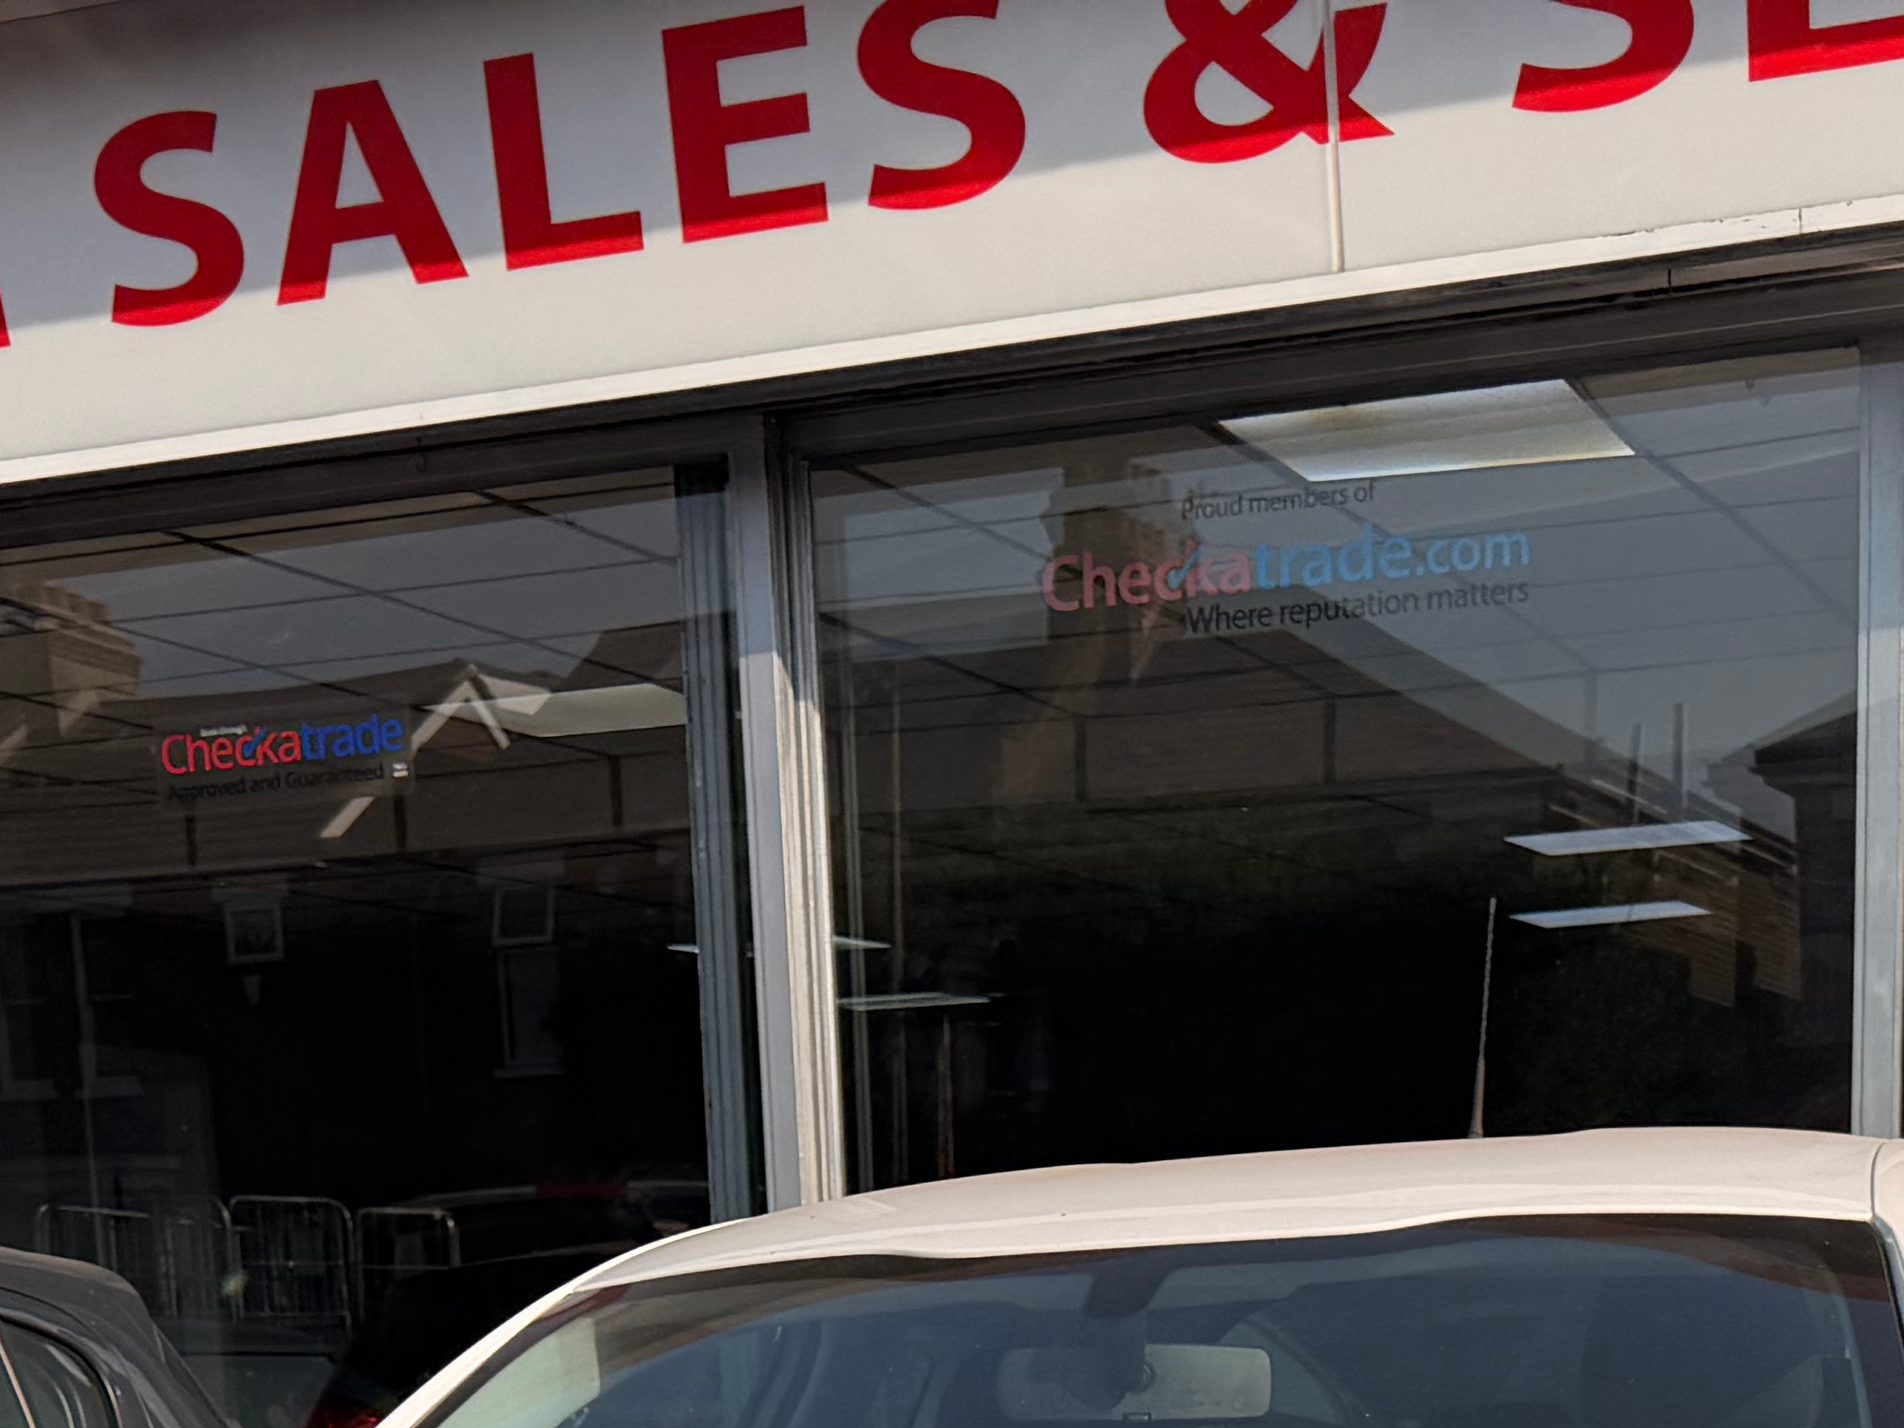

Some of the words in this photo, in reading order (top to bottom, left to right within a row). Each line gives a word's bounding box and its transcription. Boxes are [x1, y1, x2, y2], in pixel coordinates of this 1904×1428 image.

[95, 0, 1027, 328] SALES
[1181, 493, 1243, 520] Proud
[1249, 489, 1346, 513] members
[1353, 482, 1376, 503] of
[1041, 522, 1531, 612] Checkatrade.com
[1187, 603, 1272, 633] Where
[1280, 591, 1419, 630] reputation
[1427, 581, 1530, 610] matters
[161, 712, 404, 776] Checkatrade
